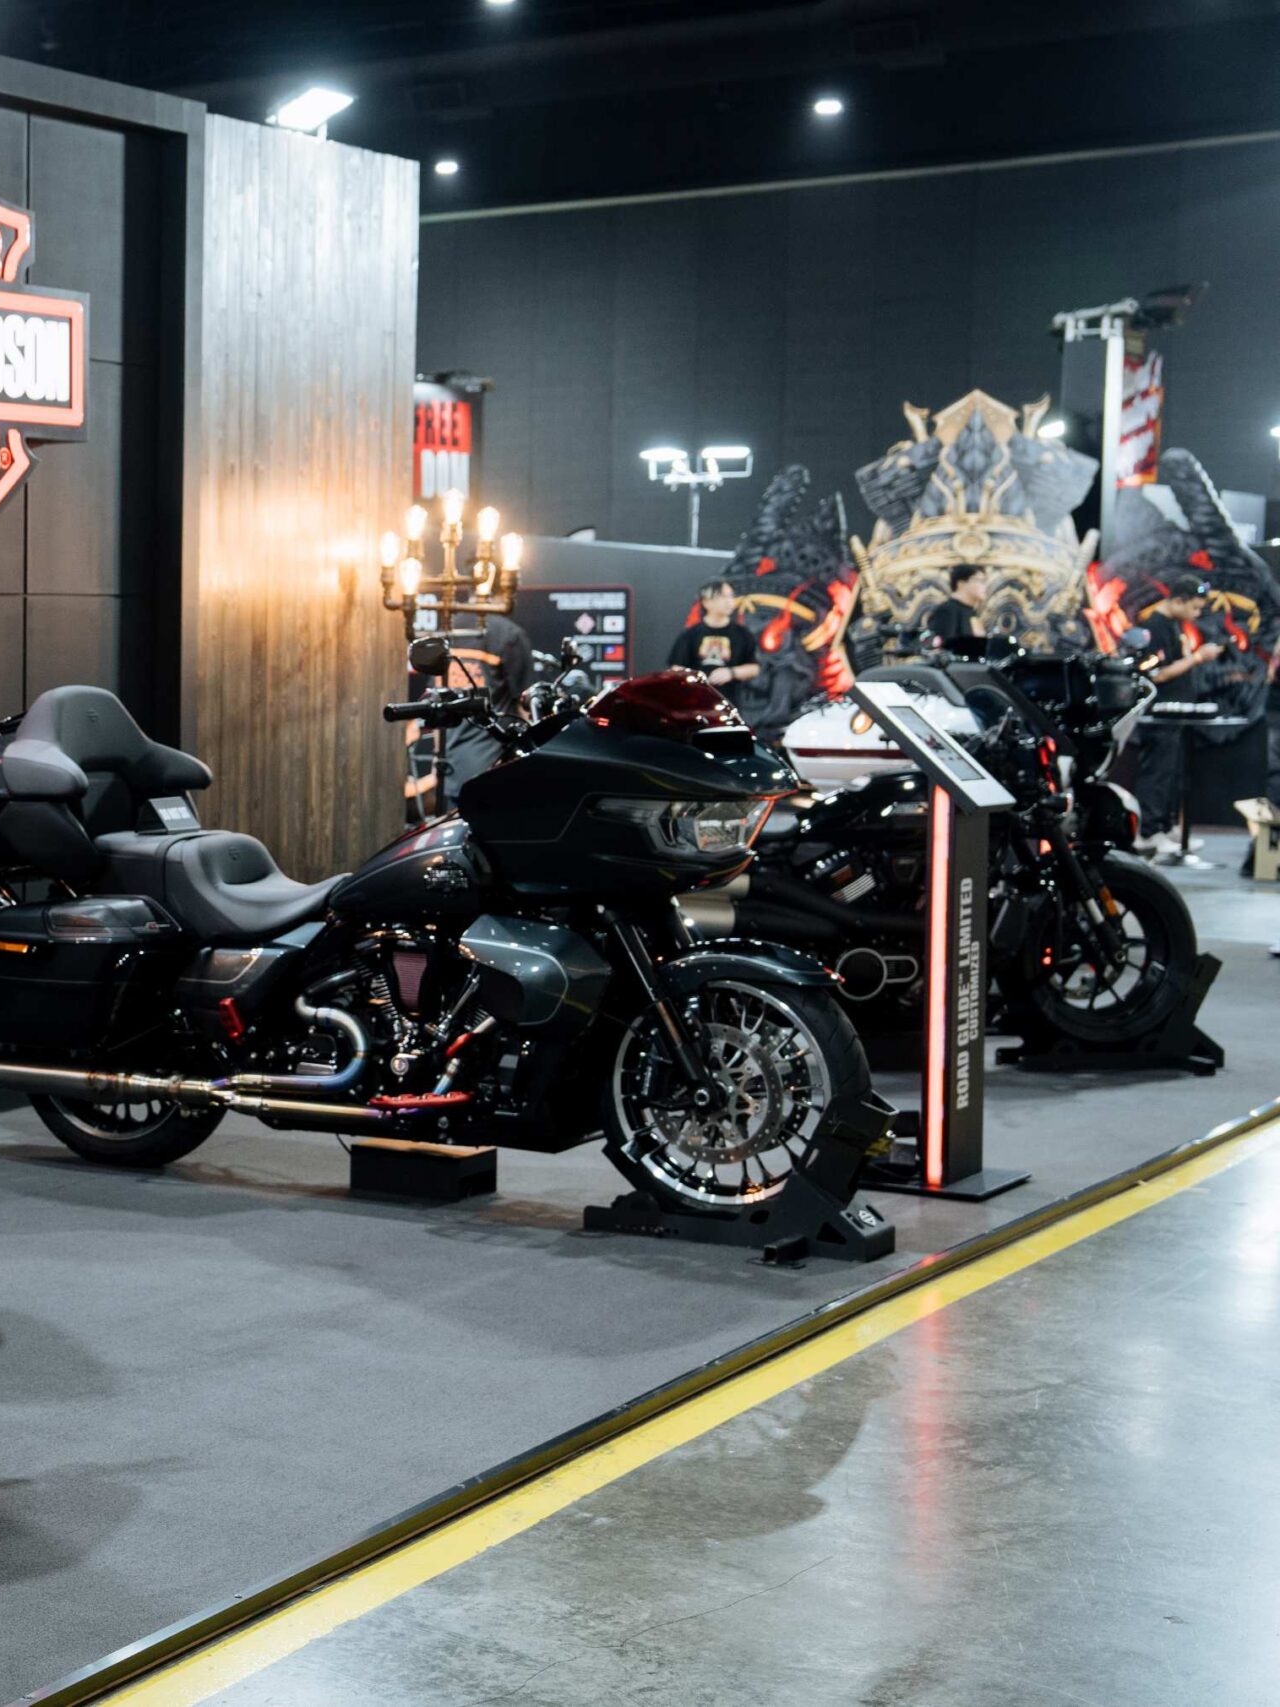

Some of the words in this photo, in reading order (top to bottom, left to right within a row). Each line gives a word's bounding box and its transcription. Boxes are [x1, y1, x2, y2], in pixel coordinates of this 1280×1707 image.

[959, 877, 973, 967] LIMITED
[970, 940, 980, 1040] CUSTOMIZED
[956, 1050, 969, 1110] ROAD
